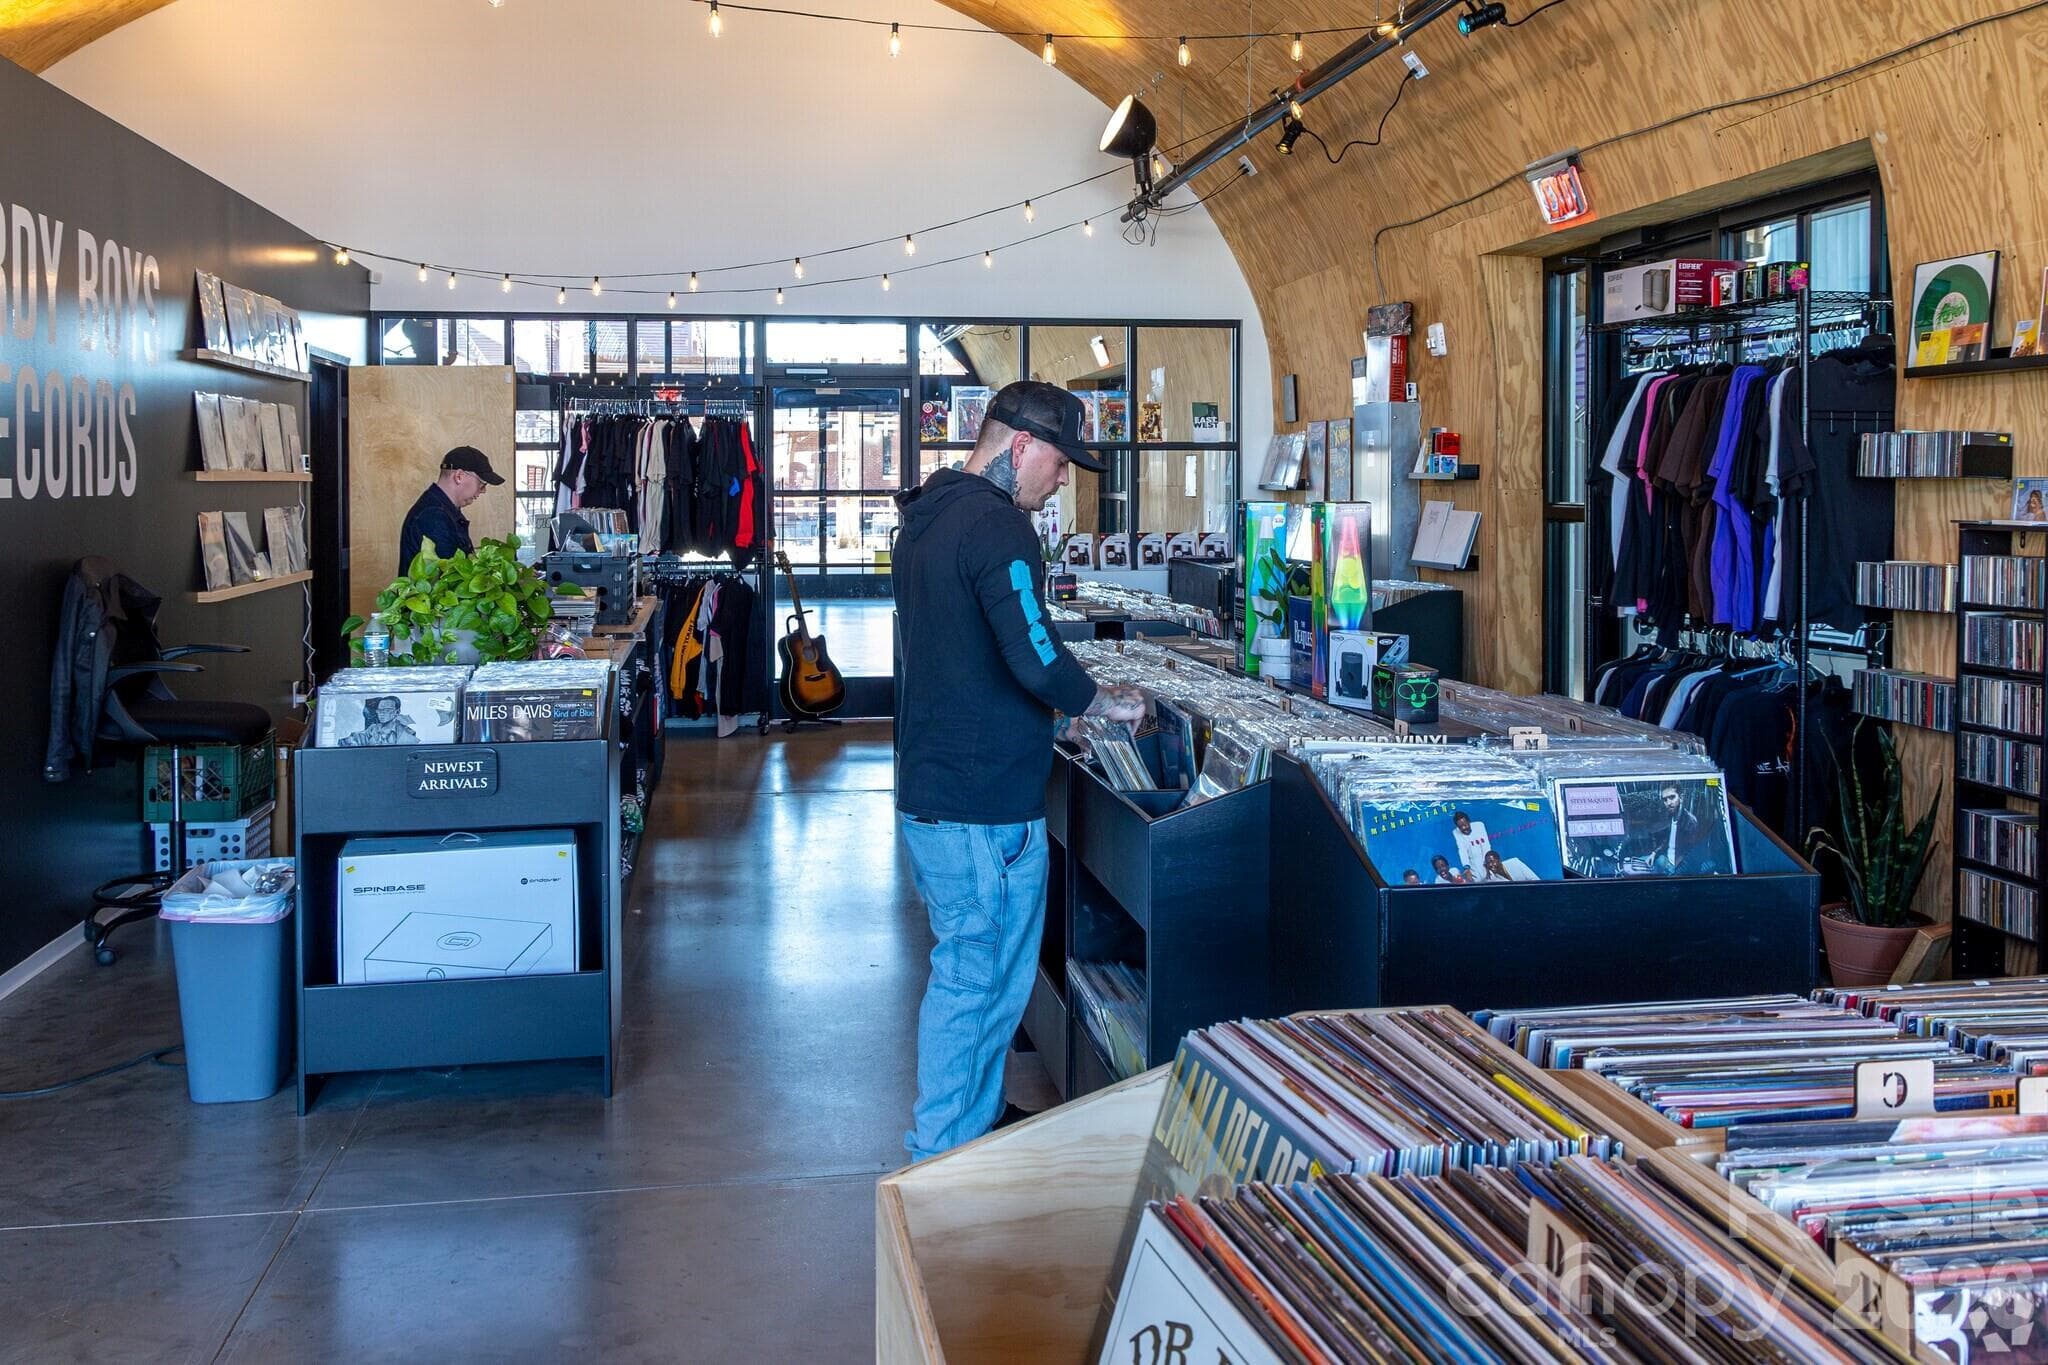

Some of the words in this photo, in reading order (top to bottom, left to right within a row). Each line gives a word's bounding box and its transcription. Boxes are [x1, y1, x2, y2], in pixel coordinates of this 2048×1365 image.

[0, 201, 64, 345] DY
[78, 228, 160, 366] BOYS
[1194, 416, 1218, 424] EAST
[467, 704, 507, 721] MILES
[512, 703, 552, 719] DAVIS
[553, 709, 569, 718] Kind
[570, 709, 578, 717] of
[580, 708, 595, 717] Blue
[424, 760, 484, 774] NEWEST
[418, 777, 488, 791] ARRIVALS
[1370, 803, 1457, 836] MANHATTANS
[1373, 810, 1396, 824] THE
[353, 884, 426, 894] SPINBASE
[1155, 1048, 1229, 1183] LANA
